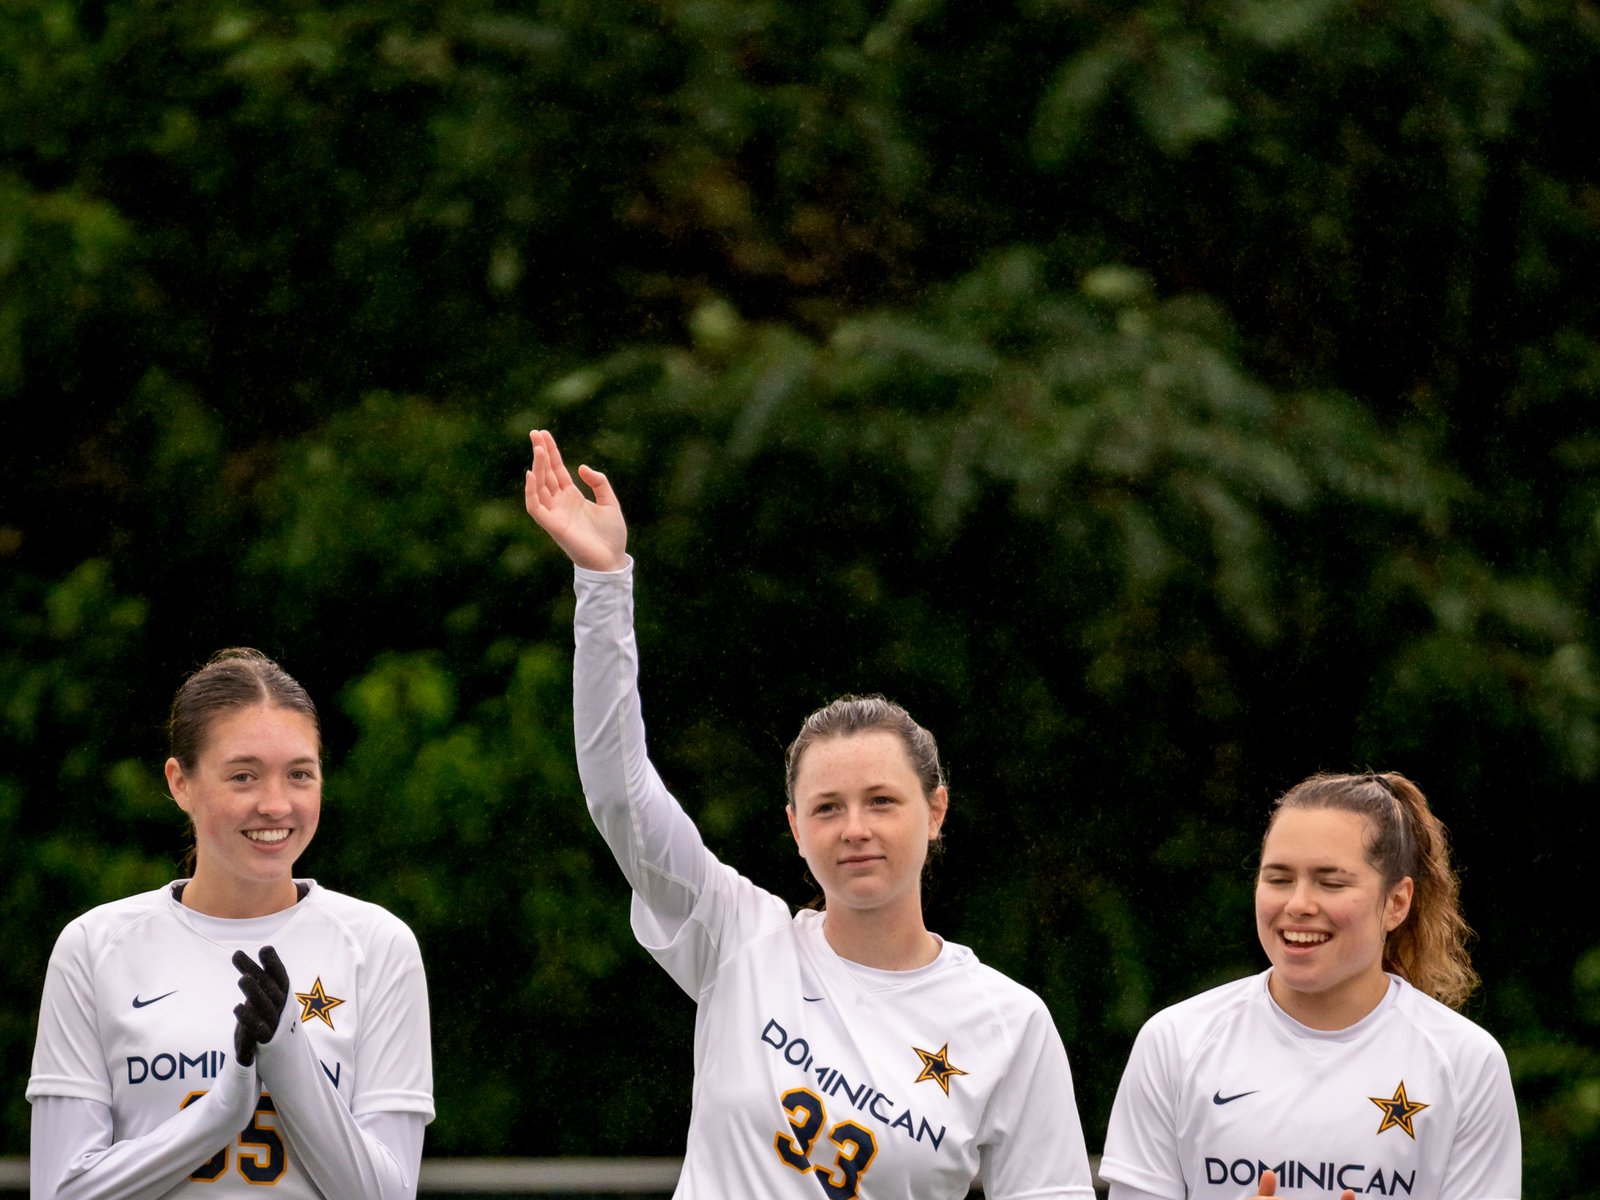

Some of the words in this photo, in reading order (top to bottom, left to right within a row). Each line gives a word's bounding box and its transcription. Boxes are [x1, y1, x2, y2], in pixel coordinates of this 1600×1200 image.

[126, 1050, 341, 1090] DOMIN
[761, 1018, 946, 1152] DOMINICAN
[1204, 1157, 1416, 1197] DOMINICAN
